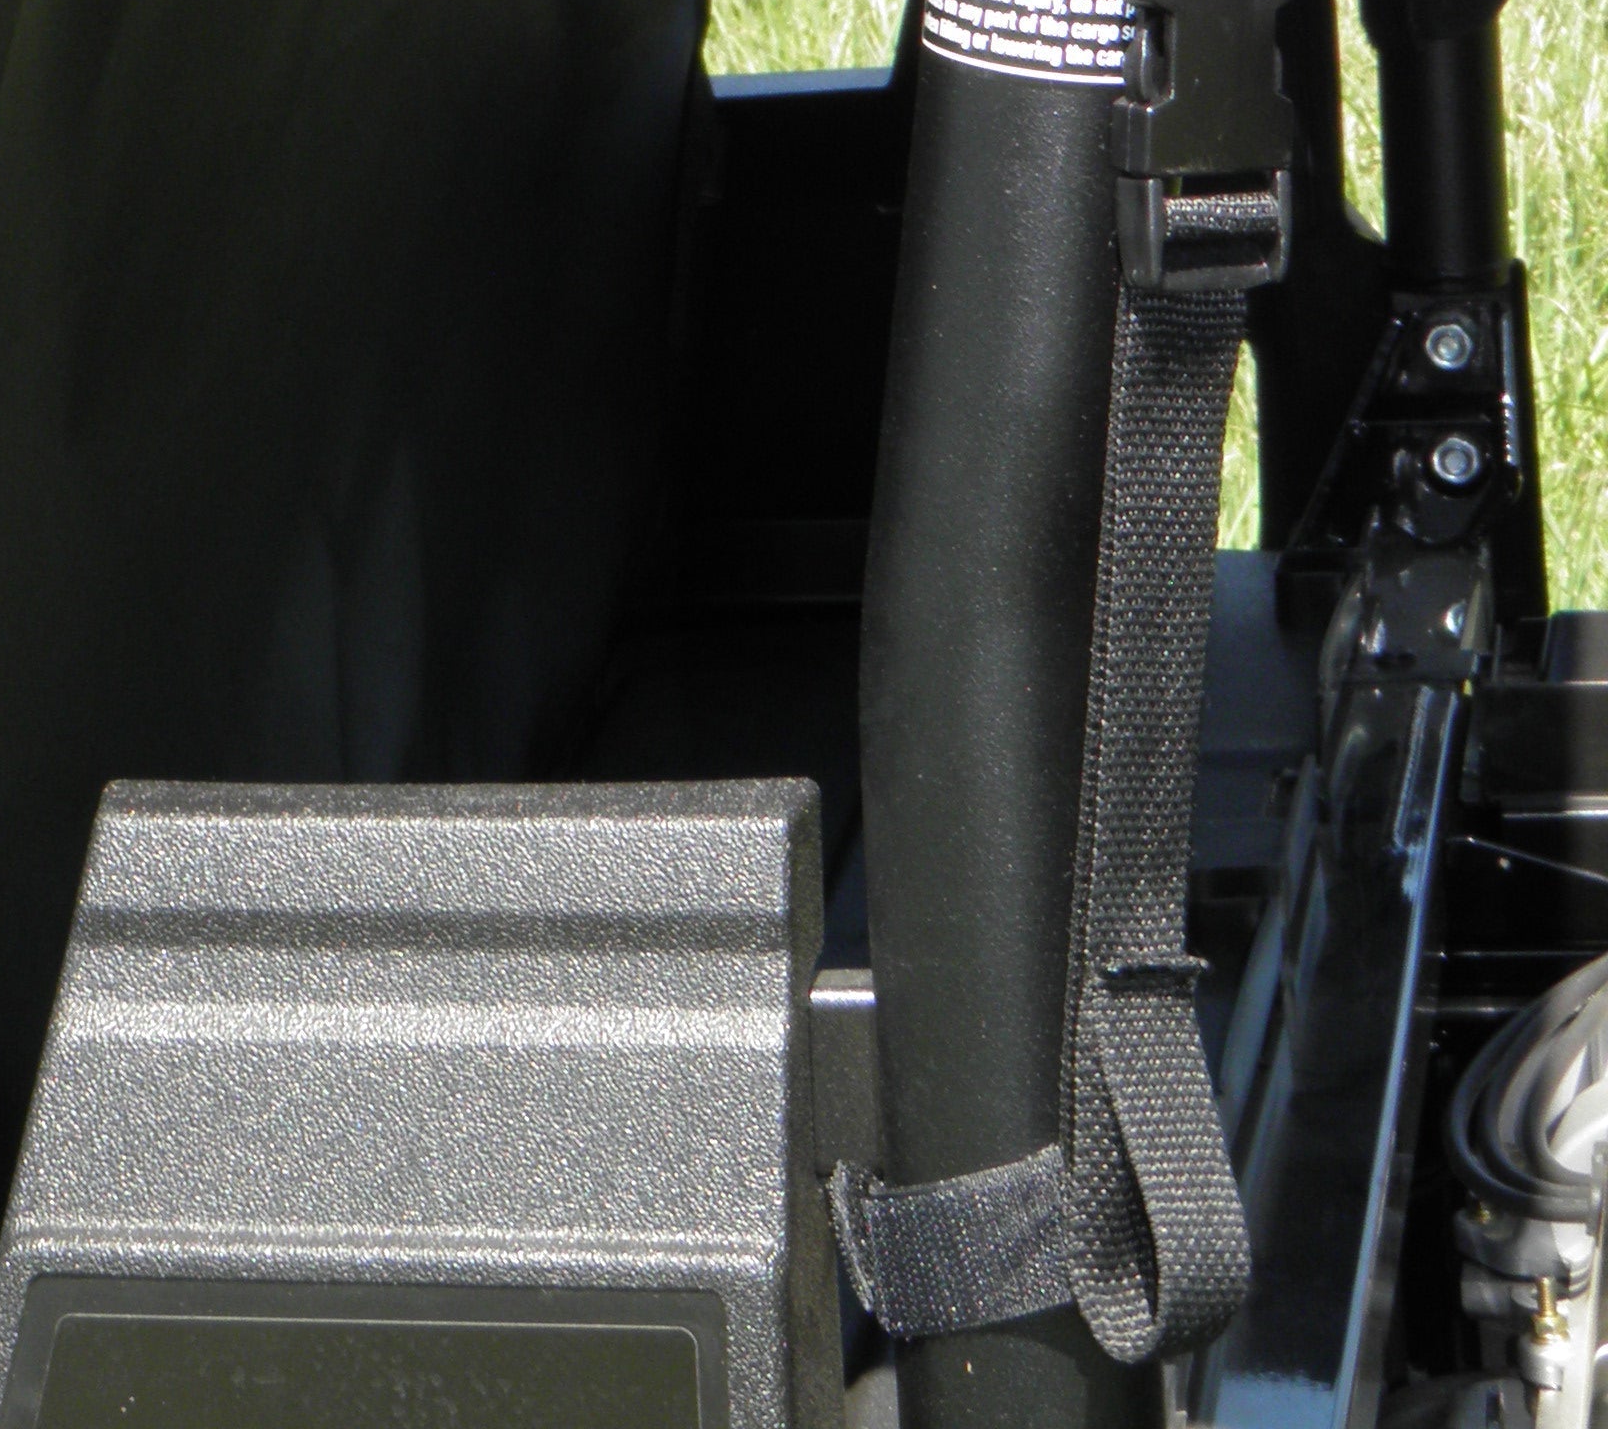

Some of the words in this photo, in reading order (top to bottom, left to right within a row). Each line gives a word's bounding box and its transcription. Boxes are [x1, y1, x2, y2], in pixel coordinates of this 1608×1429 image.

[958, 3, 983, 27] any
[984, 10, 1017, 31] part
[1019, 13, 1039, 34] of
[1040, 14, 1069, 38] the
[1071, 22, 1120, 45] cargo
[972, 32, 990, 51] or
[991, 33, 1063, 67] lowering
[1065, 44, 1095, 66] the
[1096, 50, 1125, 67] car
